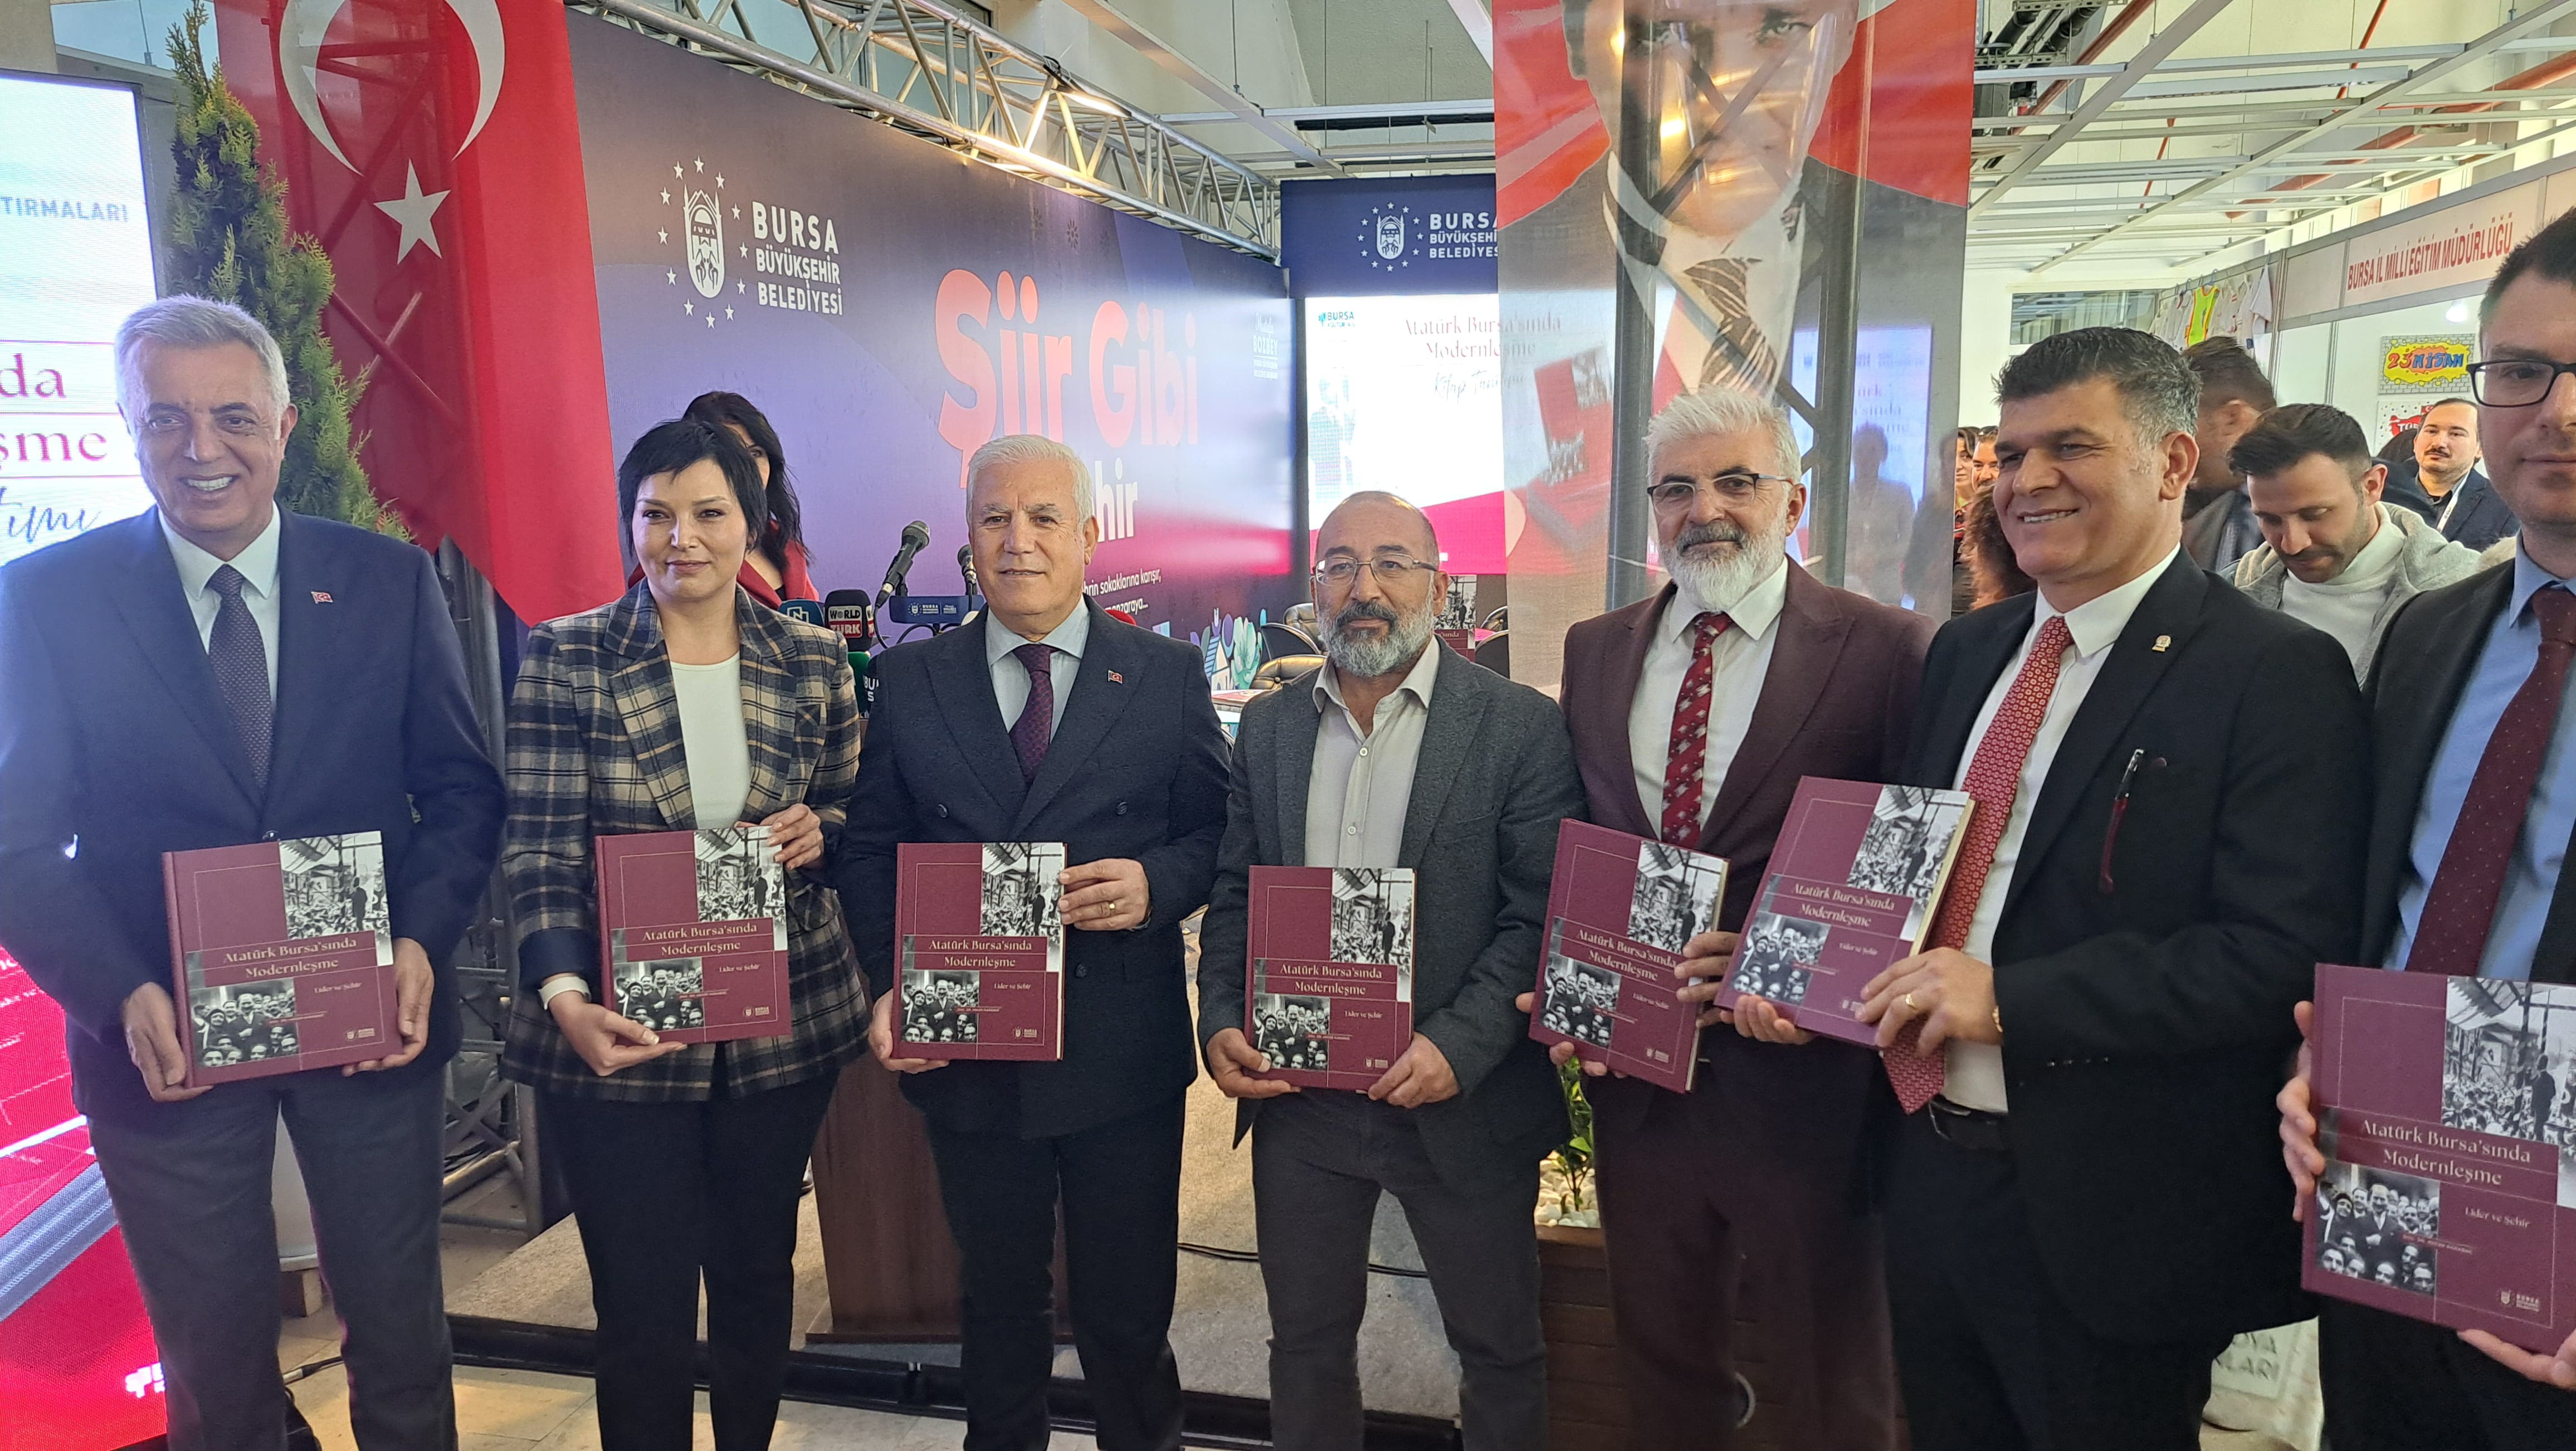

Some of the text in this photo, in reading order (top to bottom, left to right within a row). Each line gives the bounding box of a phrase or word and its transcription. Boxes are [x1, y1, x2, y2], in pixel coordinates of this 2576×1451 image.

[752, 201, 839, 255] BURSA
[1429, 212, 1497, 230] BURS
[1429, 229, 1497, 246] BÜYÜKŞEHİ
[1429, 244, 1498, 259] BELEDİYES
[2348, 212, 2513, 290] BURSA İL MİLLİ EĞİTİM MÜDÜRLÜĞÜ
[755, 244, 841, 286] BÜYÜKŞEHİR
[758, 281, 843, 316] BELEDİYESİ
[1328, 311, 1354, 320] BURSA
[1406, 315, 1461, 335] Atatürk
[2387, 352, 2413, 369] 23
[935, 268, 1199, 488] Şiir Gibi
[1092, 457, 1138, 543] hir
[1082, 567, 1162, 596] hrin sokaklarına karışır,
[830, 609, 861, 619] WORLD
[1792, 883, 1830, 899] Atatürk
[1799, 903, 1872, 927] Modernleşme
[642, 922, 757, 941] Atatürk Bursa'sında
[1578, 929, 1615, 950] Atatürk
[223, 937, 357, 963] Atatürk Bursa'sında
[661, 941, 740, 956] Modernleşme
[929, 939, 1032, 951] Atatürk Bursa'sında
[245, 958, 339, 978] Modernleşme
[944, 955, 1016, 970] Modernleşme
[1280, 963, 1383, 979] Atatürk Bursa'sında
[1588, 950, 1659, 982] Modernleşme
[1295, 981, 1367, 996] Modernleşme
[2362, 1118, 2531, 1163] Atatürk Bursa'sında
[2383, 1148, 2502, 1186] Modernleşme
[2465, 1206, 2490, 1220] Lider
